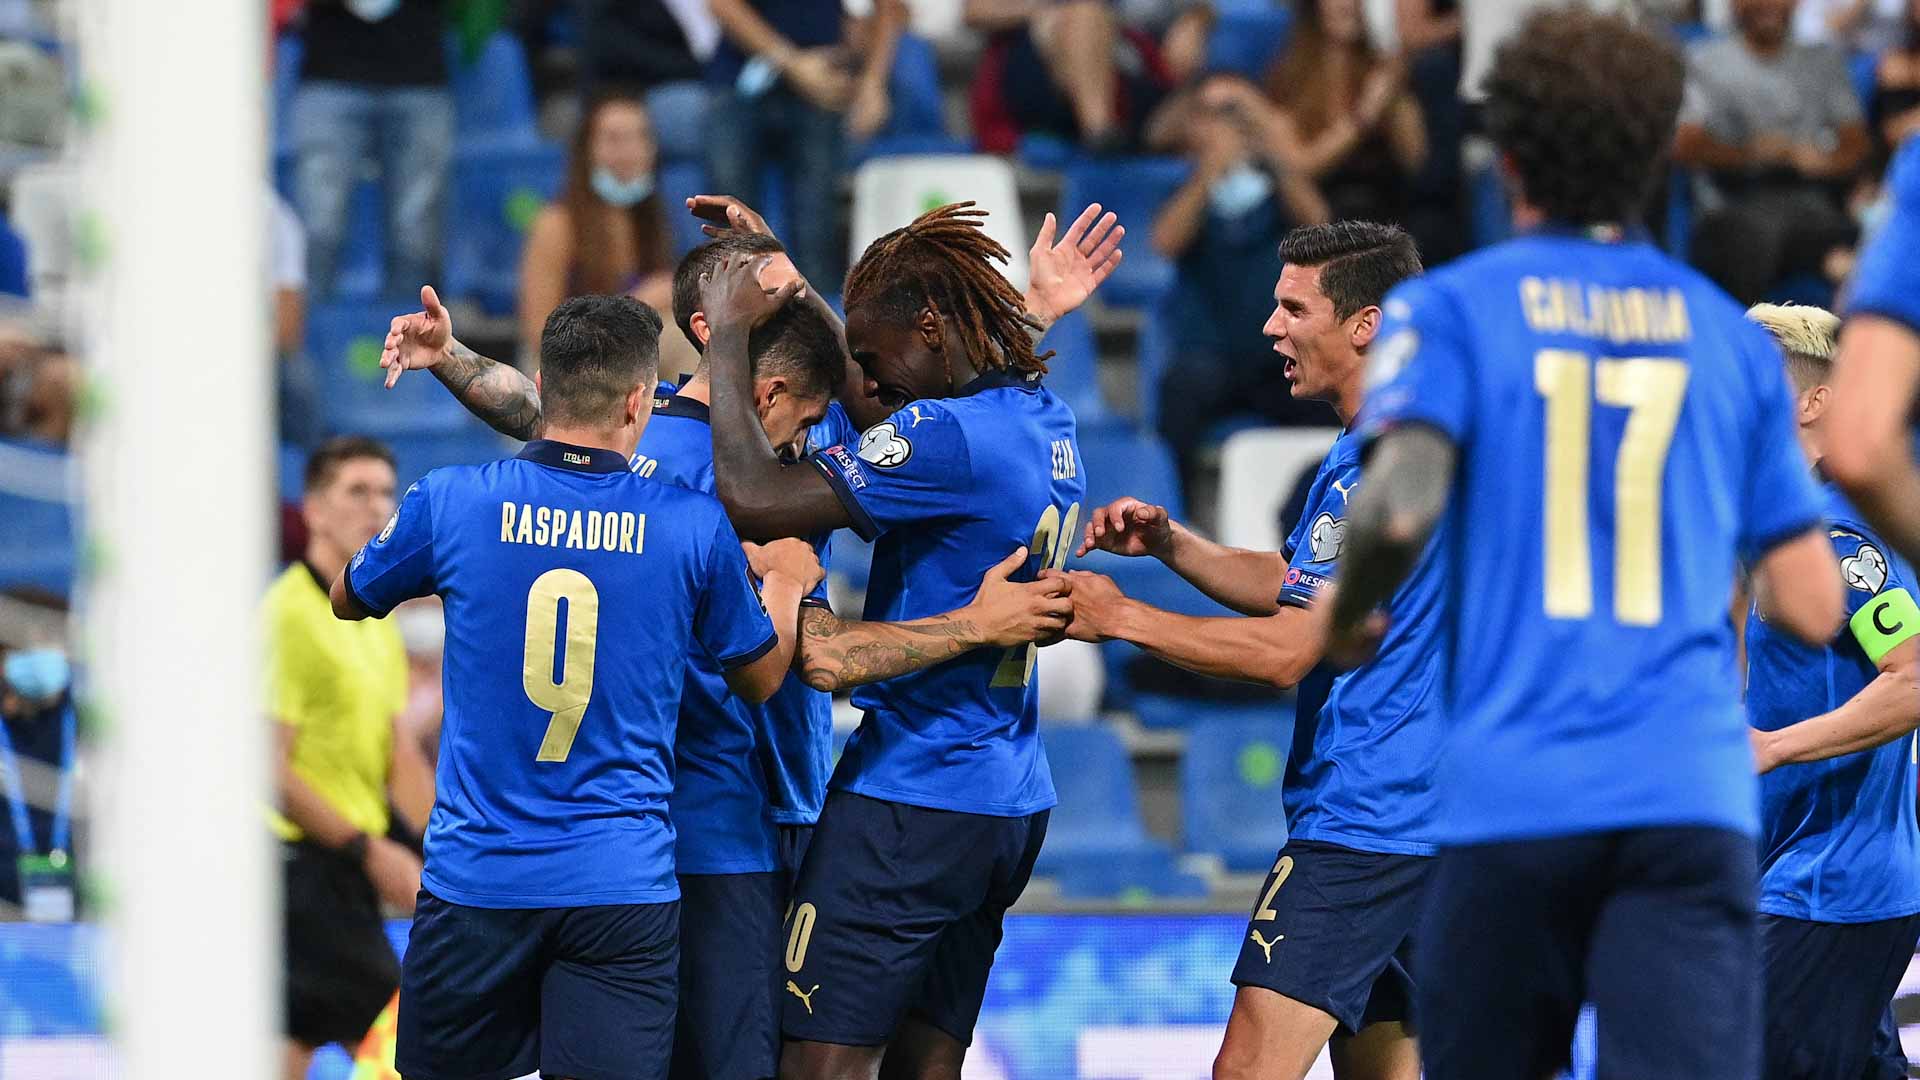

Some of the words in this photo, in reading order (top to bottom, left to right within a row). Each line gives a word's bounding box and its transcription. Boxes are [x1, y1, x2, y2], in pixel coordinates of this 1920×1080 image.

[563, 452, 591, 465] ITALIA
[835, 451, 866, 488] RESPECT
[1534, 349, 1690, 626] 17
[500, 501, 646, 554] RASPADORI
[1298, 574, 1332, 590] RESPE
[1872, 602, 1903, 635] C
[523, 568, 599, 762] 9
[783, 899, 816, 973] 0
